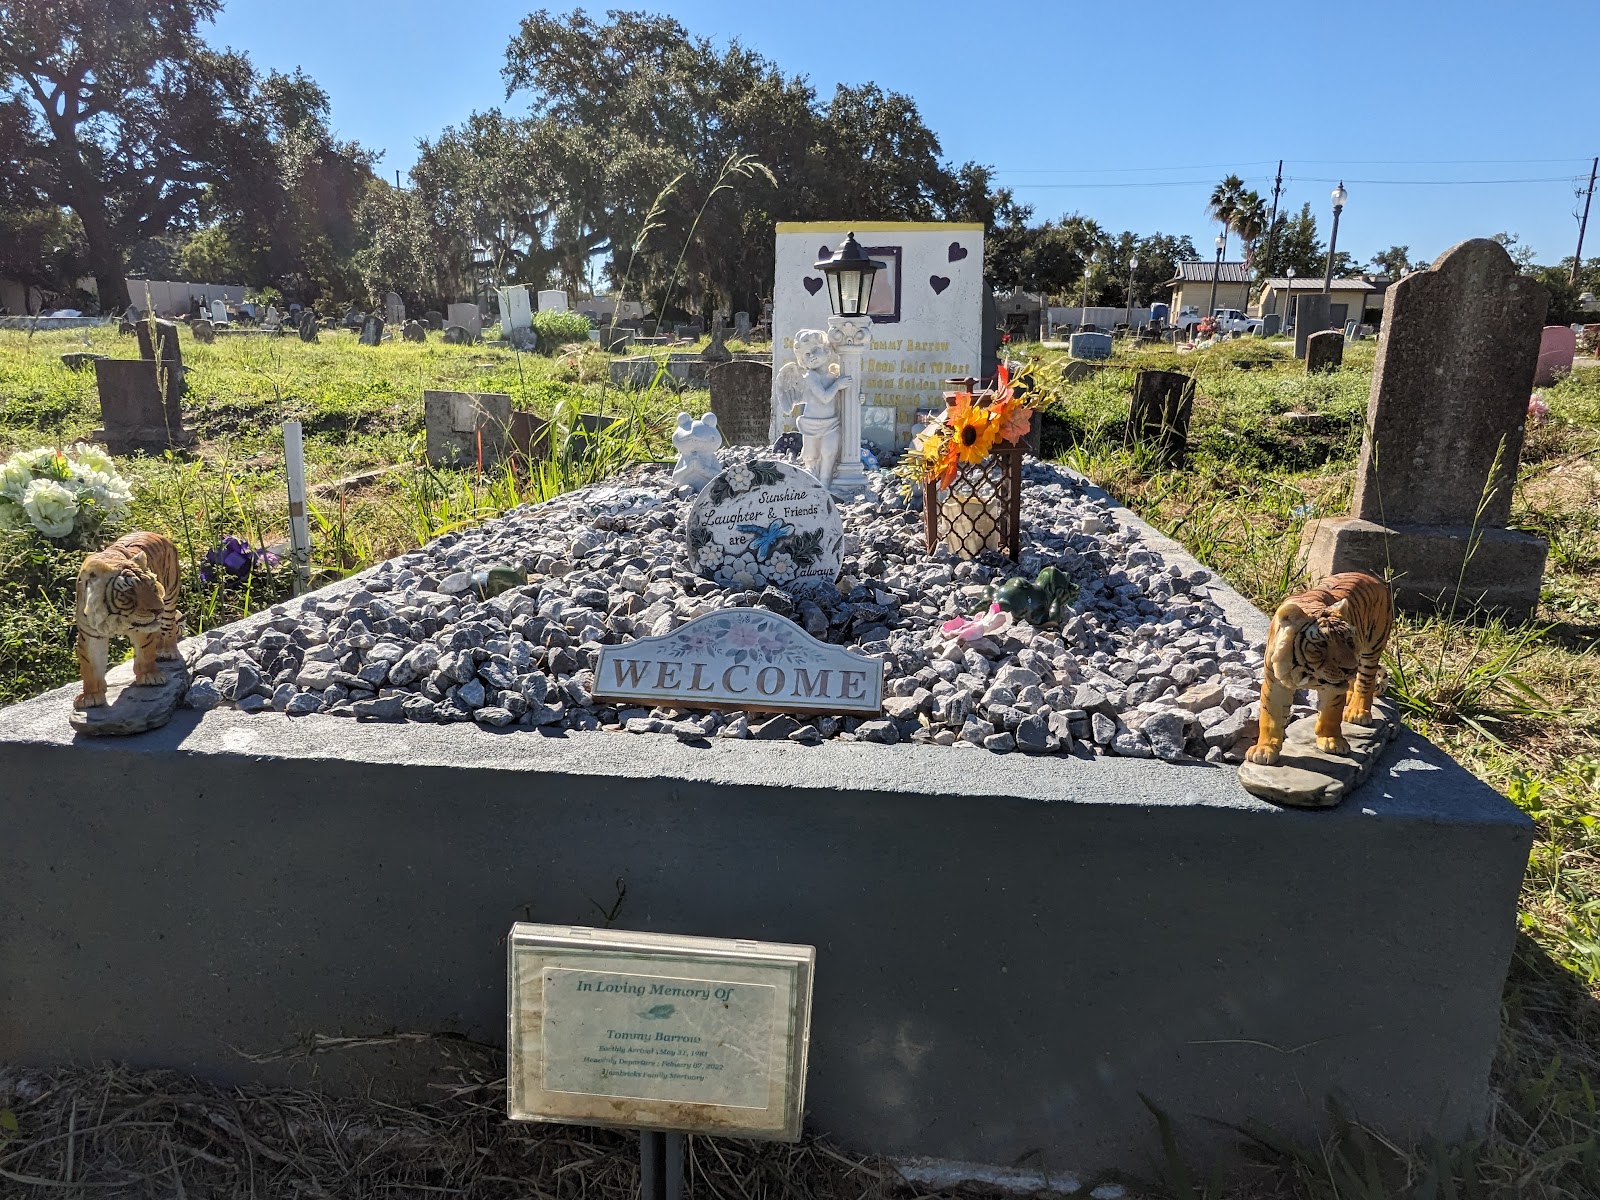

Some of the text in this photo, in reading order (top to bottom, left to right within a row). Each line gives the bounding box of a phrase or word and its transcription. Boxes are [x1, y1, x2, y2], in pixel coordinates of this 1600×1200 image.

[906, 339, 950, 352] Barrow
[900, 360, 926, 374] Laid
[758, 488, 808, 505] Sunshine
[702, 504, 819, 531] Laughter & Friends
[729, 535, 748, 546] are
[801, 564, 835, 577] always
[611, 657, 868, 701] WELCOME
[576, 980, 735, 1002] In Loving Memory Of
[606, 1029, 702, 1044] Tommy Barrow
[598, 1045, 626, 1054] Earthly
[627, 1046, 654, 1054] Arrival
[619, 1058, 656, 1067] Departure
[669, 1073, 705, 1082] Mortuary
